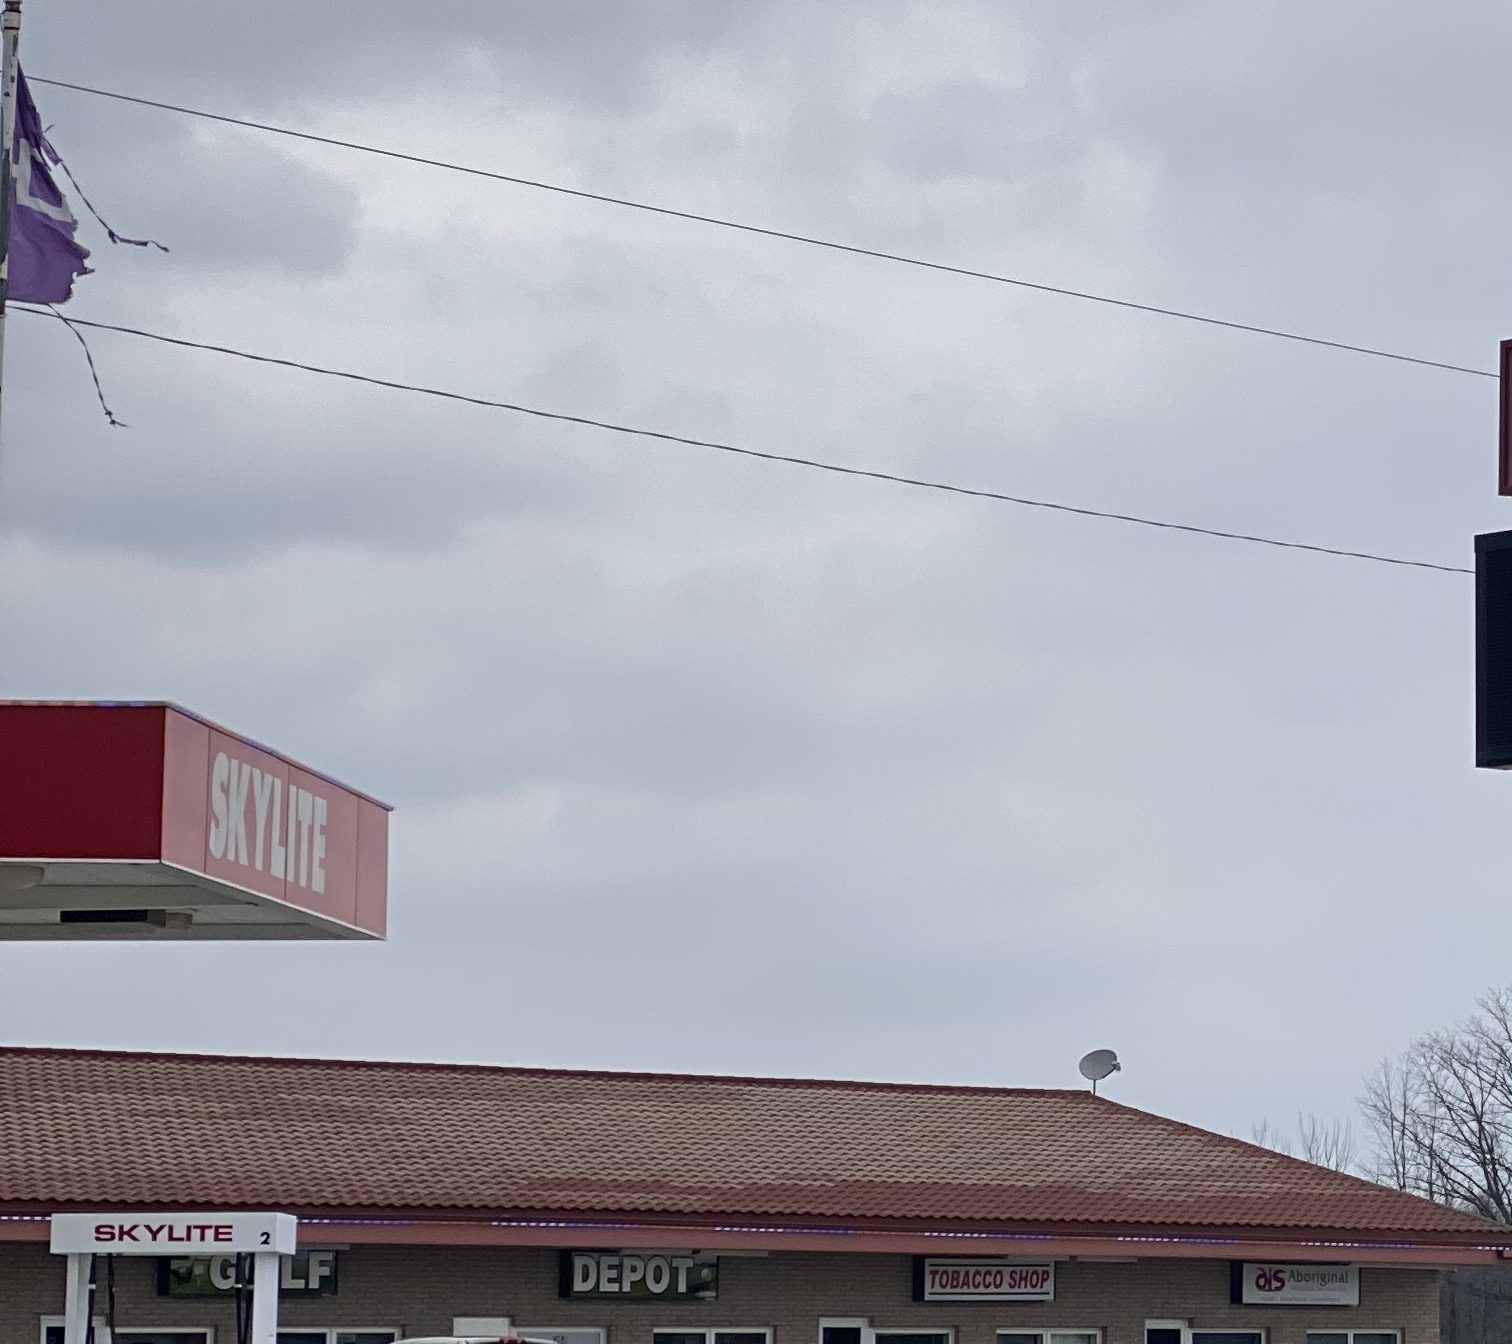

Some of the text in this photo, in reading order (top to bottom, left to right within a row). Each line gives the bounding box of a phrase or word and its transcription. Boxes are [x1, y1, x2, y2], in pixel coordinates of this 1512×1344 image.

[209, 752, 327, 894] SKYLITE
[94, 1225, 270, 1244] SKYLITE 2
[210, 1252, 333, 1290] GLF
[573, 1256, 693, 1293] DEPOT
[929, 1270, 1049, 1289] TOBACCO SHOP
[1288, 1270, 1348, 1286] Aboriginal
